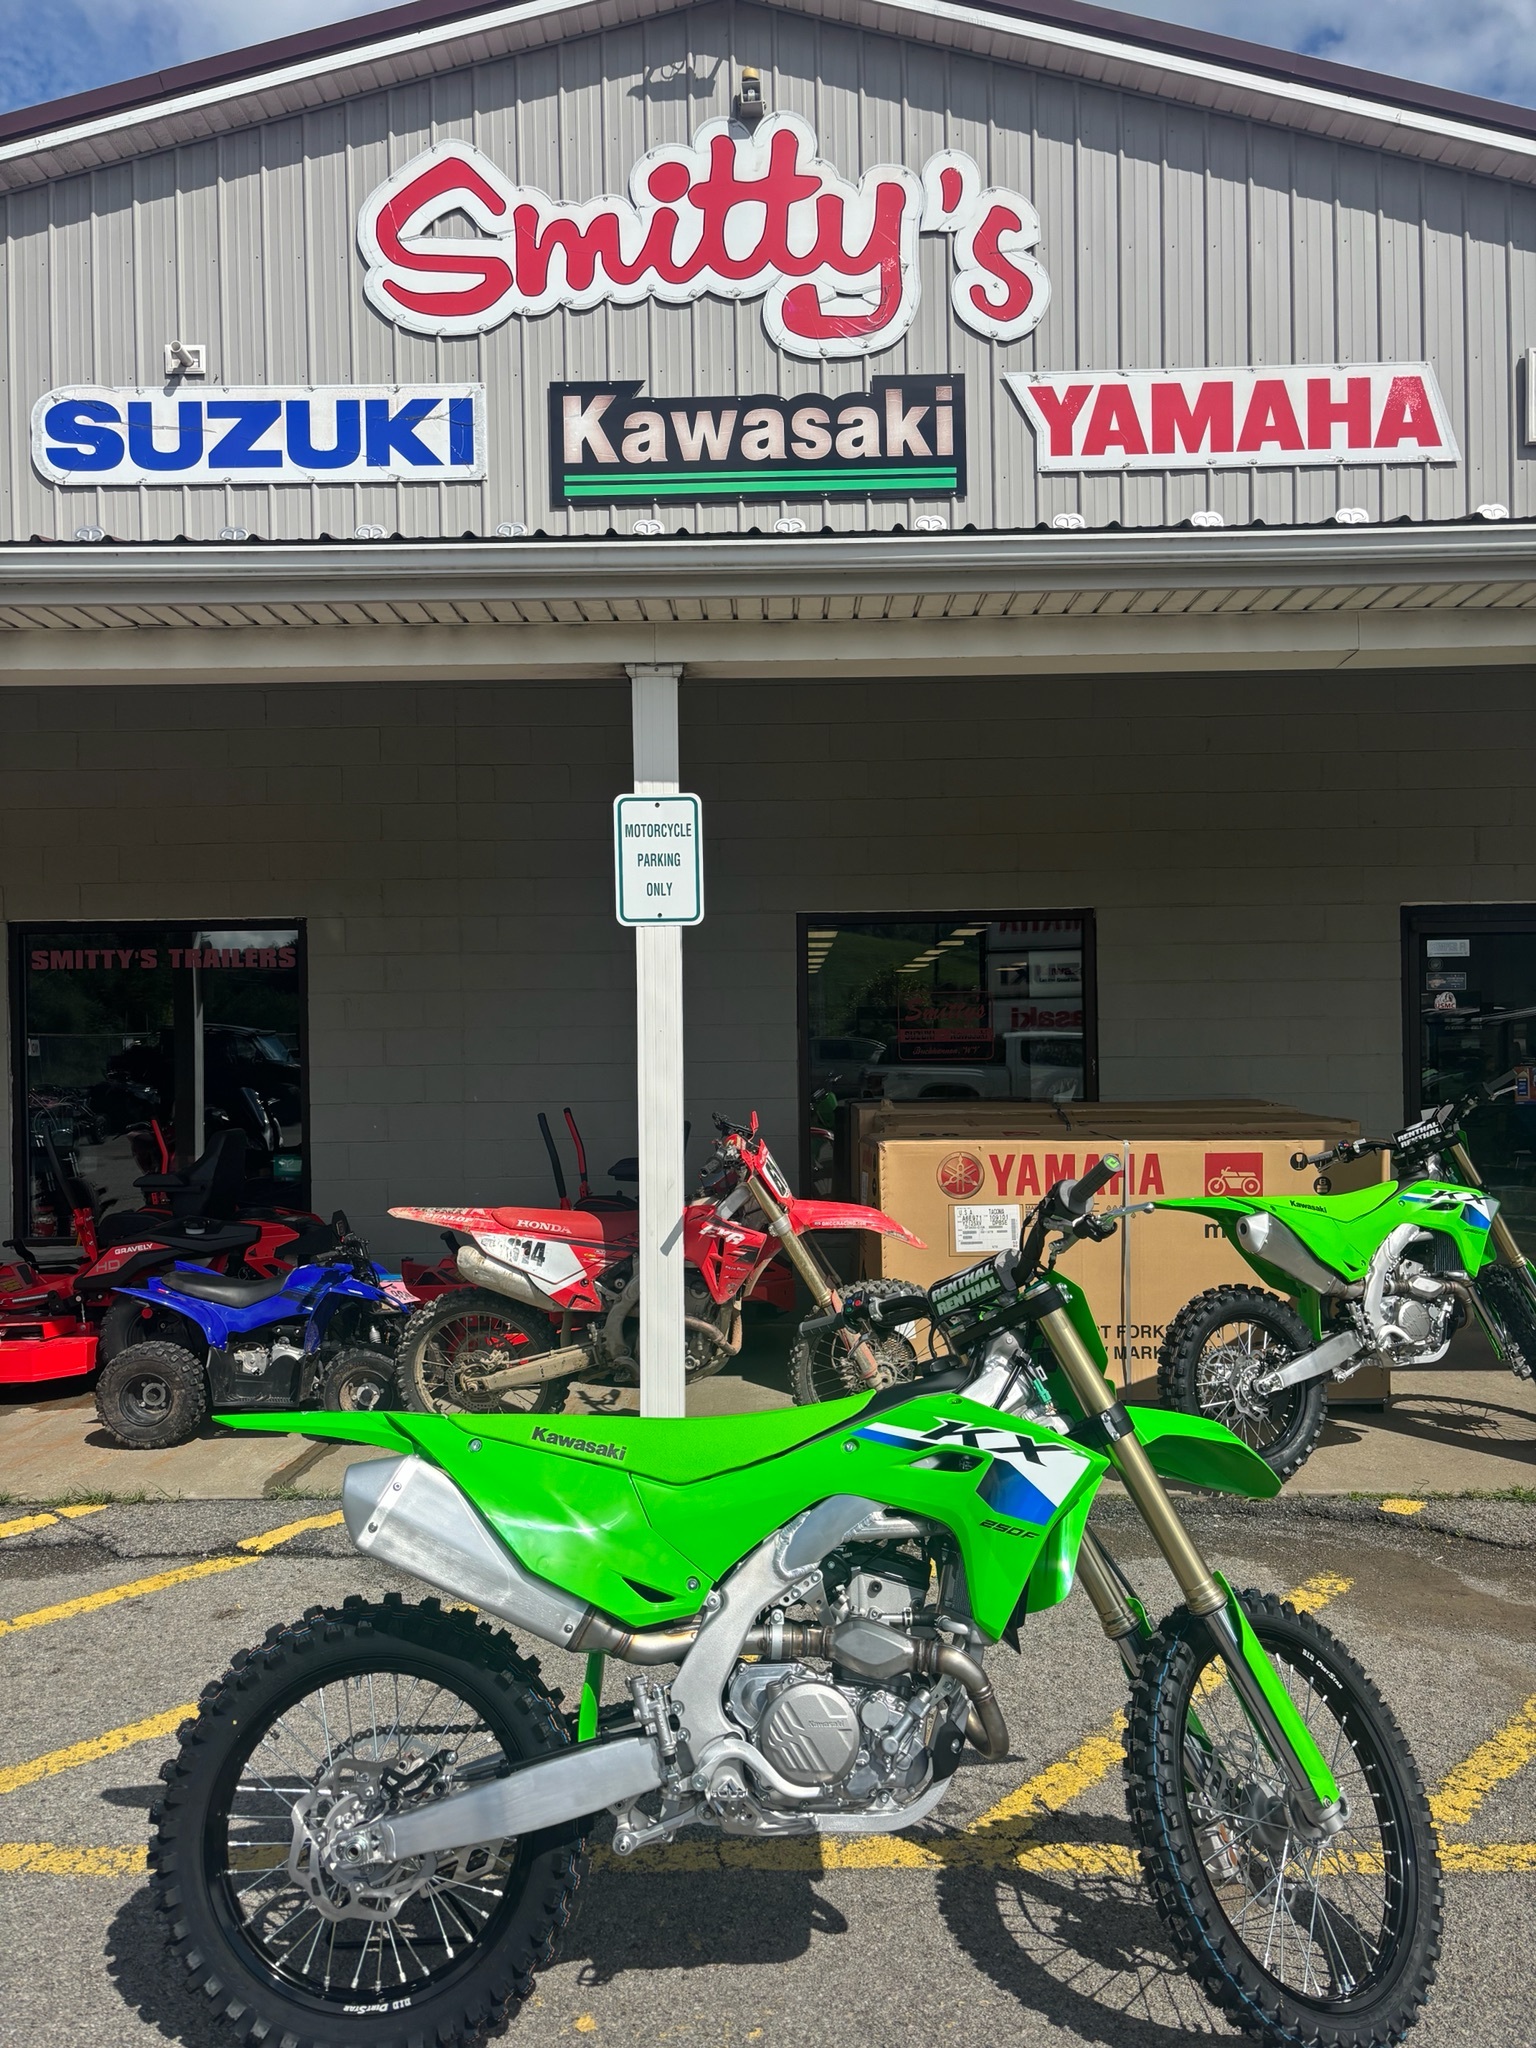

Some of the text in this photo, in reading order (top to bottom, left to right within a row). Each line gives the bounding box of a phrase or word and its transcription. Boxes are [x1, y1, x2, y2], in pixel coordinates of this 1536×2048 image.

[376, 130, 1032, 338] Smitty's
[563, 386, 953, 464] Kawasaki
[1028, 375, 1442, 457] YAMAHA
[45, 398, 474, 471] SUZUKI
[624, 823, 692, 838] MOTORCYCLE
[637, 852, 681, 867] PARKING
[646, 882, 673, 896] ONLY
[31, 948, 296, 970] SMITTY'S TRAILERS
[1397, 1121, 1439, 1142] RENTHAL
[1289, 1200, 1327, 1213] Kawasaki
[516, 1219, 572, 1234] HONDA
[114, 1243, 153, 1255] GRAVELY
[95, 1259, 121, 1273] HD
[931, 1264, 994, 1303] RENTHAL
[936, 1276, 1001, 1316] RENTHAL
[531, 1426, 627, 1461] Kawasaki
[920, 1420, 1073, 1467] KX
[979, 1519, 1040, 1538] 250F
